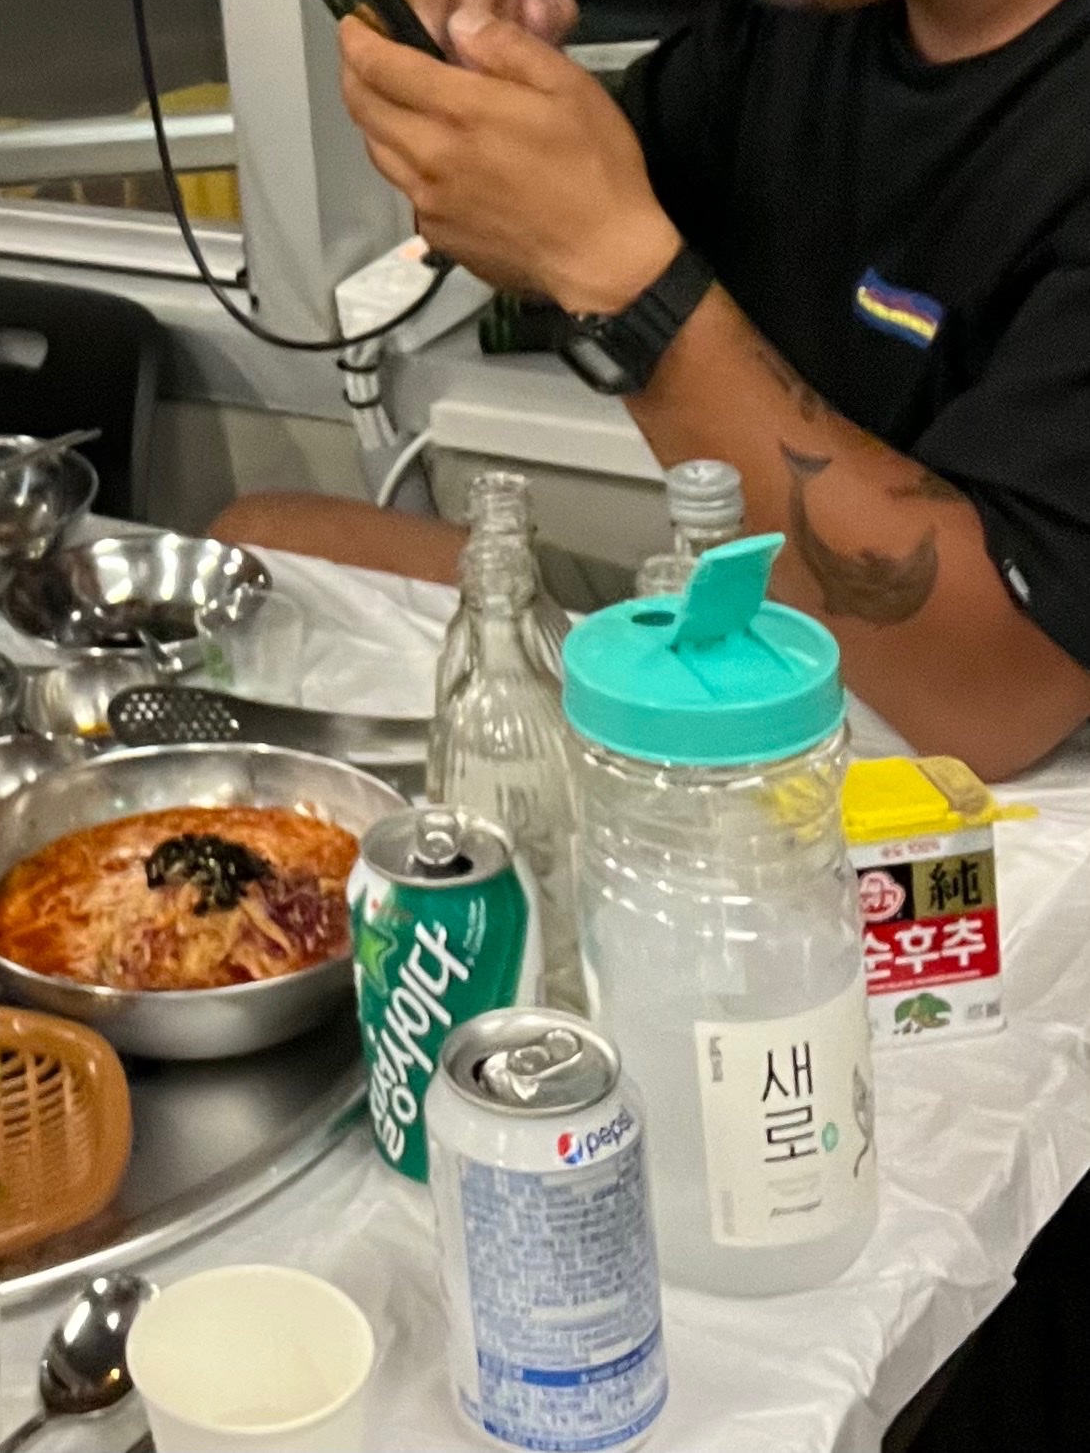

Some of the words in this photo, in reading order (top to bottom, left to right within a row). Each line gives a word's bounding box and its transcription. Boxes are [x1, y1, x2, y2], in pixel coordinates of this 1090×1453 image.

[928, 859, 983, 911] 純
[862, 917, 987, 980] 순후추
[760, 1040, 818, 1163] 새로
